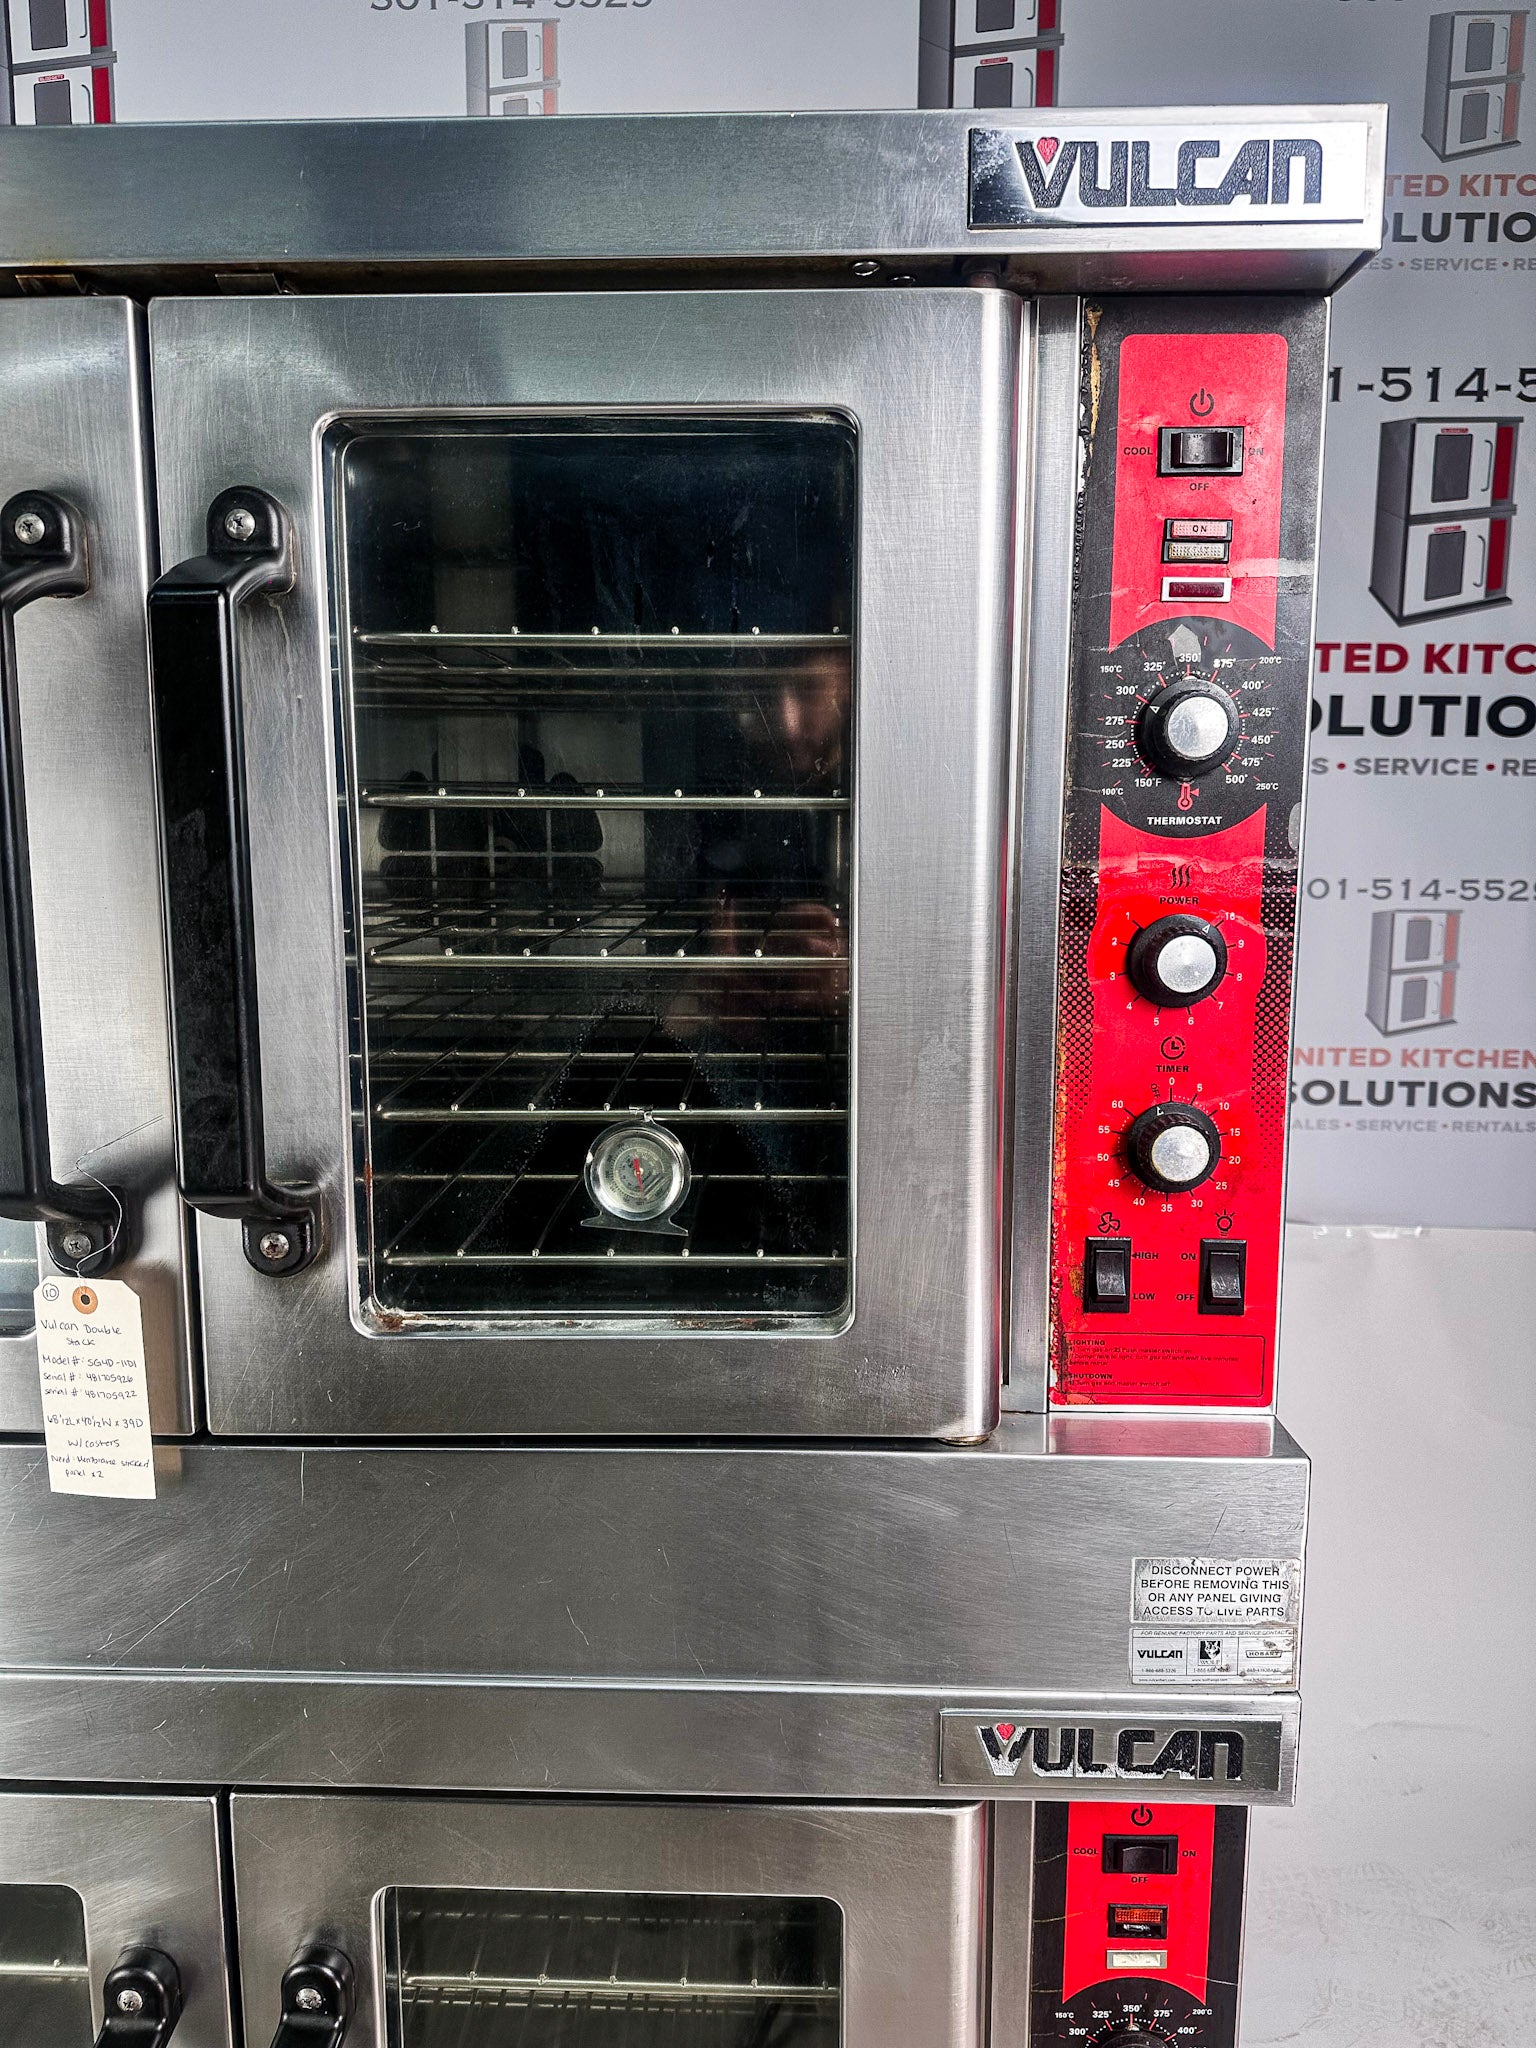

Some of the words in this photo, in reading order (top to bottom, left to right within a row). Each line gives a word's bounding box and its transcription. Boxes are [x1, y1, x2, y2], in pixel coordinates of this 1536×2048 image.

[1016, 137, 1323, 208] VULCAN
[1382, 212, 1536, 243] LUTIO
[1410, 258, 1497, 271] SERVICE
[1123, 447, 1153, 456] COOL
[1189, 483, 1210, 491] OFF
[1192, 525, 1208, 533] ON
[1423, 643, 1536, 675] KITC
[1143, 661, 1166, 671] 325°
[1115, 685, 1139, 695] 300°
[1241, 680, 1265, 690] 400°
[1105, 716, 1128, 726] 275°
[1310, 695, 1536, 738] LUTIO
[1105, 739, 1128, 749] 250°
[1251, 735, 1274, 745] 450°
[1112, 758, 1135, 768] 225°
[1241, 757, 1263, 767] 475°
[1353, 758, 1479, 776] SERVICE
[1225, 774, 1248, 784] 500°
[1147, 816, 1222, 825] THERMOSTAT
[1159, 896, 1199, 905] POWER
[1125, 912, 1130, 920] 1
[1111, 937, 1118, 946] 2
[1237, 940, 1244, 948] 9
[1109, 972, 1116, 981] 3
[1236, 973, 1243, 982] 8
[1126, 1002, 1132, 1011] 4
[1218, 1002, 1224, 1010] 7
[1153, 1017, 1160, 1026] 5
[1188, 1017, 1194, 1025] 6
[1401, 1048, 1536, 1070] KITCHEN
[1156, 1065, 1189, 1073] TIMER
[1150, 1083, 1161, 1099] OFF
[1168, 1077, 1175, 1085] 0
[1197, 1083, 1203, 1092] 5
[1290, 1080, 1536, 1108] OLUTIONS
[1111, 1100, 1123, 1108] 60
[1219, 1102, 1230, 1110] 10
[1098, 1125, 1110, 1134] 55
[1229, 1128, 1241, 1136] 15
[1356, 1120, 1438, 1132] SERVICE
[1452, 1121, 1536, 1133] RENTALS
[1096, 1154, 1109, 1162] 50
[1228, 1156, 1241, 1164] 20
[1107, 1180, 1120, 1188] 45
[1215, 1182, 1228, 1190] 25
[1133, 1198, 1145, 1206] 40
[1161, 1204, 1173, 1212] 35
[1191, 1199, 1203, 1208] 30
[40, 1319, 79, 1331] Vulcan
[83, 1323, 122, 1335] Double
[42, 1354, 70, 1366] Model
[1151, 1566, 1233, 1577] DISCONNECT
[1235, 1566, 1280, 1577] POWER
[1141, 1579, 1190, 1589] BEFORE
[1193, 1580, 1258, 1590] REMOVING
[1262, 1580, 1289, 1590] THIS
[1148, 1592, 1166, 1602] OR
[1169, 1593, 1194, 1602] ANY
[1197, 1593, 1236, 1603] PANEL
[1239, 1593, 1281, 1603] GIVING
[1143, 1606, 1193, 1616] ACCESS
[1197, 1606, 1213, 1616] TO
[1217, 1607, 1242, 1616] LIVE
[1246, 1607, 1285, 1617] PARTS
[1137, 1650, 1183, 1659] VULCAN
[976, 1723, 1244, 1781] VULCAN
[1073, 1847, 1099, 1856] COOL
[1131, 1876, 1149, 1884] OFF
[1092, 2010, 1113, 2018] 325°
[1153, 2009, 1173, 2018] 375°
[1122, 2004, 1143, 2012] 350°
[1068, 2027, 1089, 2036] 300°
[1177, 2026, 1198, 2035] 400°
